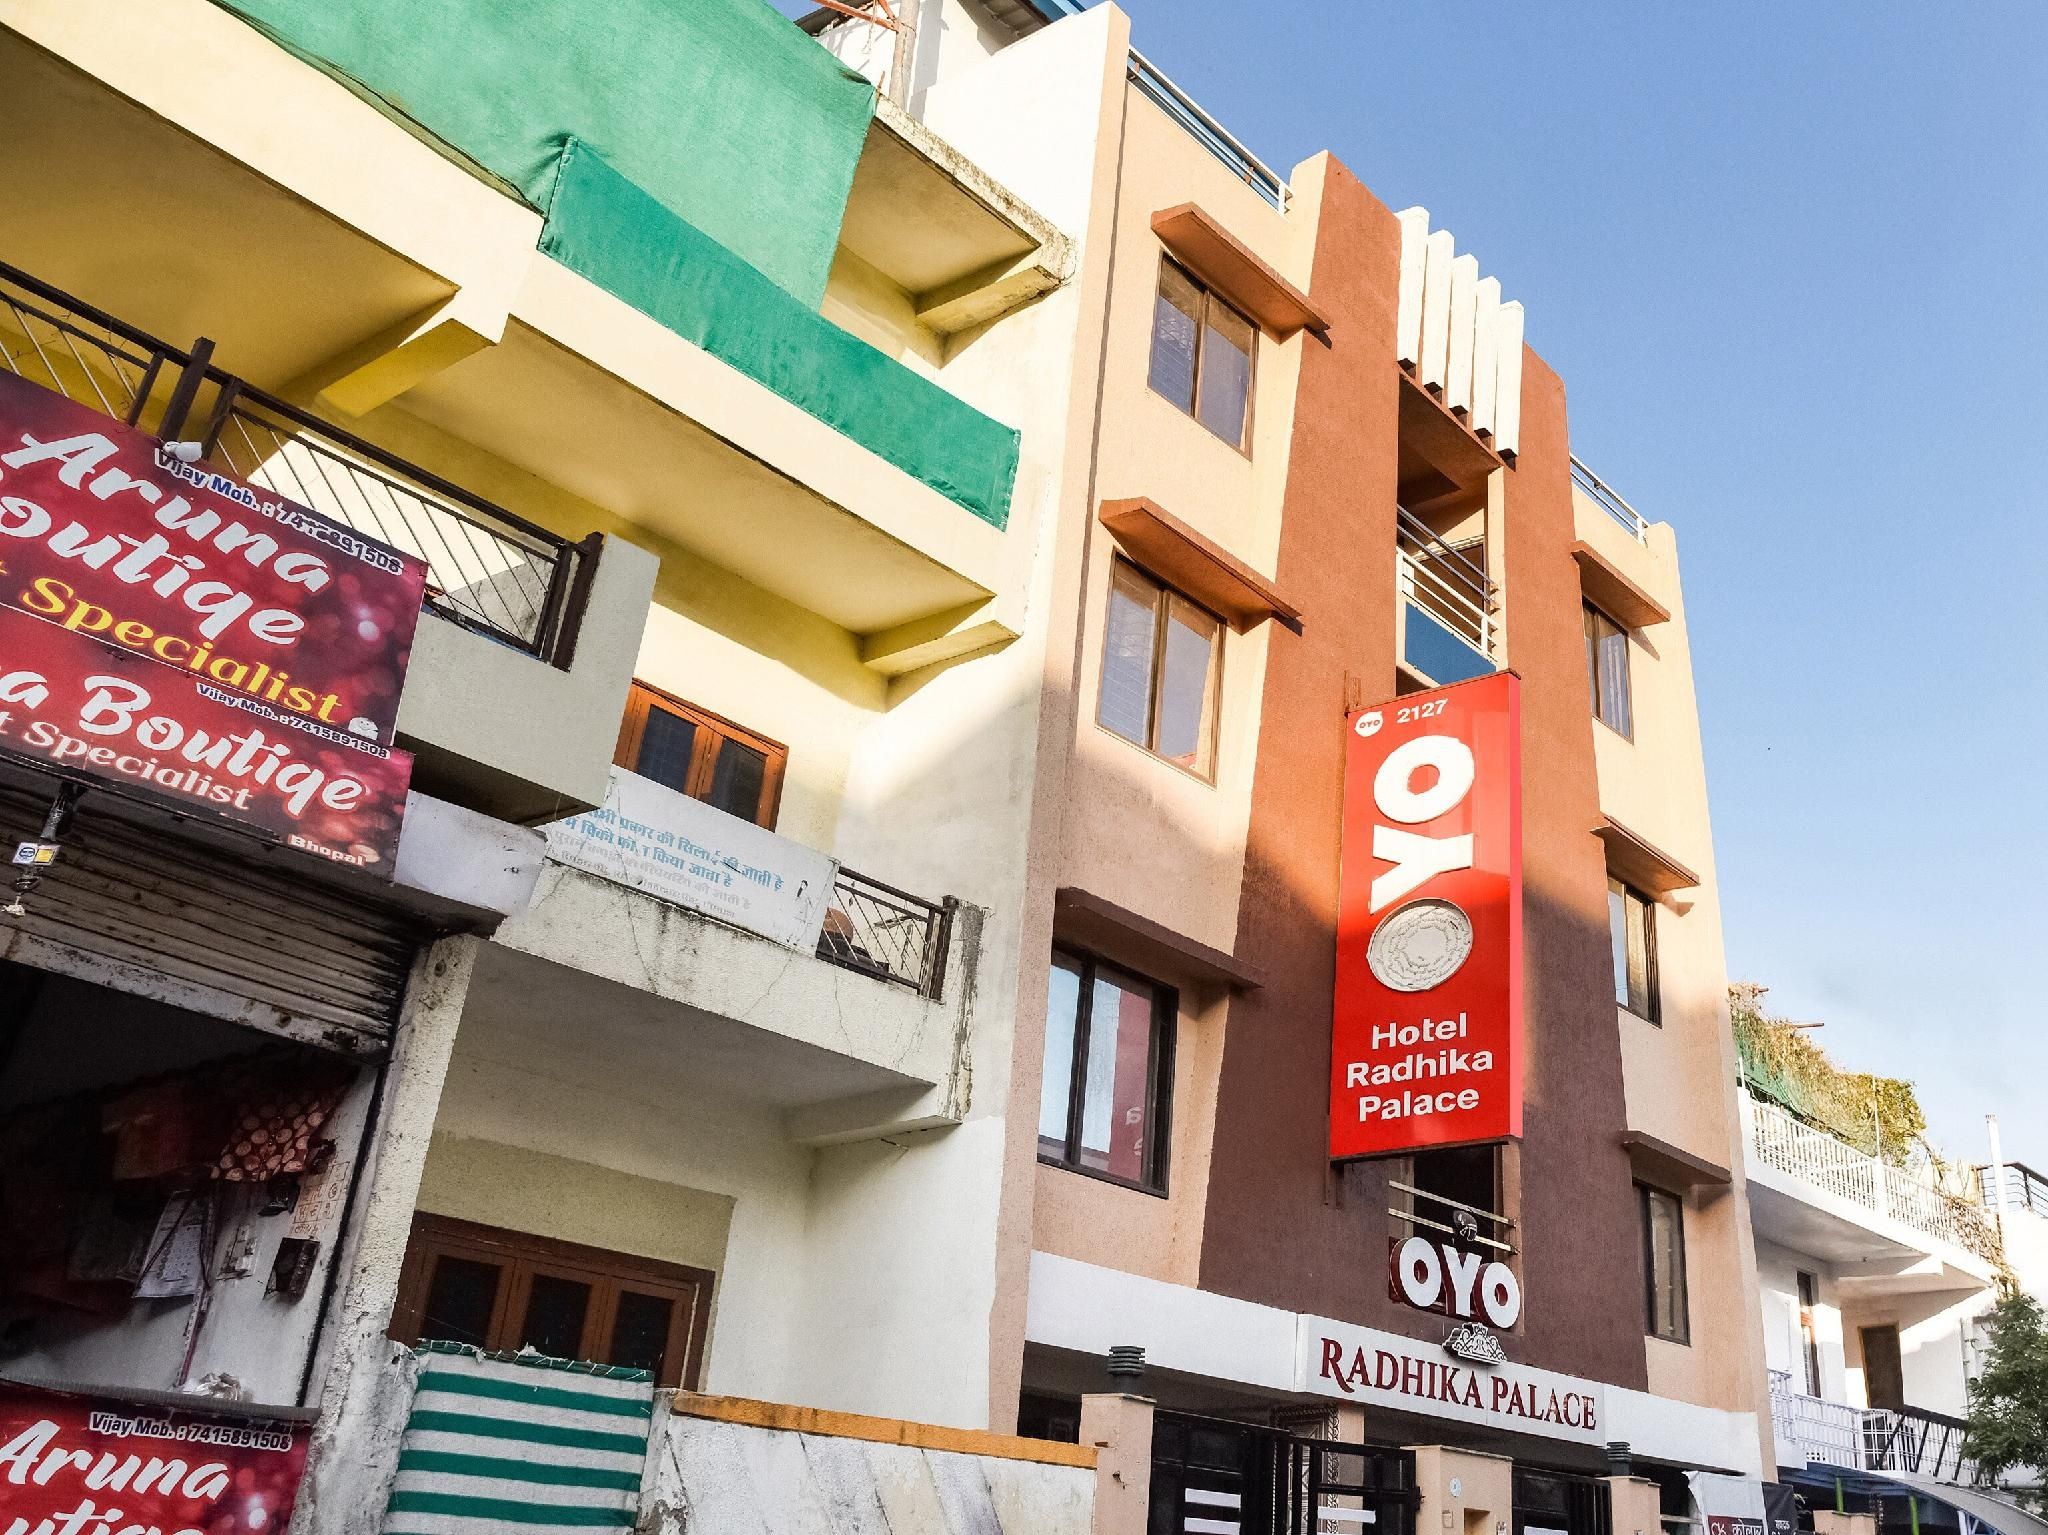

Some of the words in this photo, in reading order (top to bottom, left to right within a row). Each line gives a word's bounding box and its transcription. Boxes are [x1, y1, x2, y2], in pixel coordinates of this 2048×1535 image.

[1, 433, 329, 593] Aruna
[0, 497, 304, 645] outiqe
[22, 578, 342, 723] Specialist
[197, 683, 237, 707] Vijay
[1359, 718, 1380, 730] OYO
[1397, 698, 1449, 724] 2127
[24, 721, 252, 810] Specialist
[79, 675, 367, 815] Boutiqe
[290, 835, 366, 866] Bhopal
[1367, 734, 1475, 992] YO
[1346, 1047, 1493, 1089] Radhika
[1371, 1012, 1467, 1050] Hotel
[1358, 1085, 1480, 1123] Palace
[1394, 1236, 1521, 1329] OYO
[91, 1412, 131, 1437] Vijay
[1319, 1337, 1485, 1410] RADHIKA
[1490, 1375, 1597, 1431] PALACE
[0, 1419, 229, 1500] Aruna
